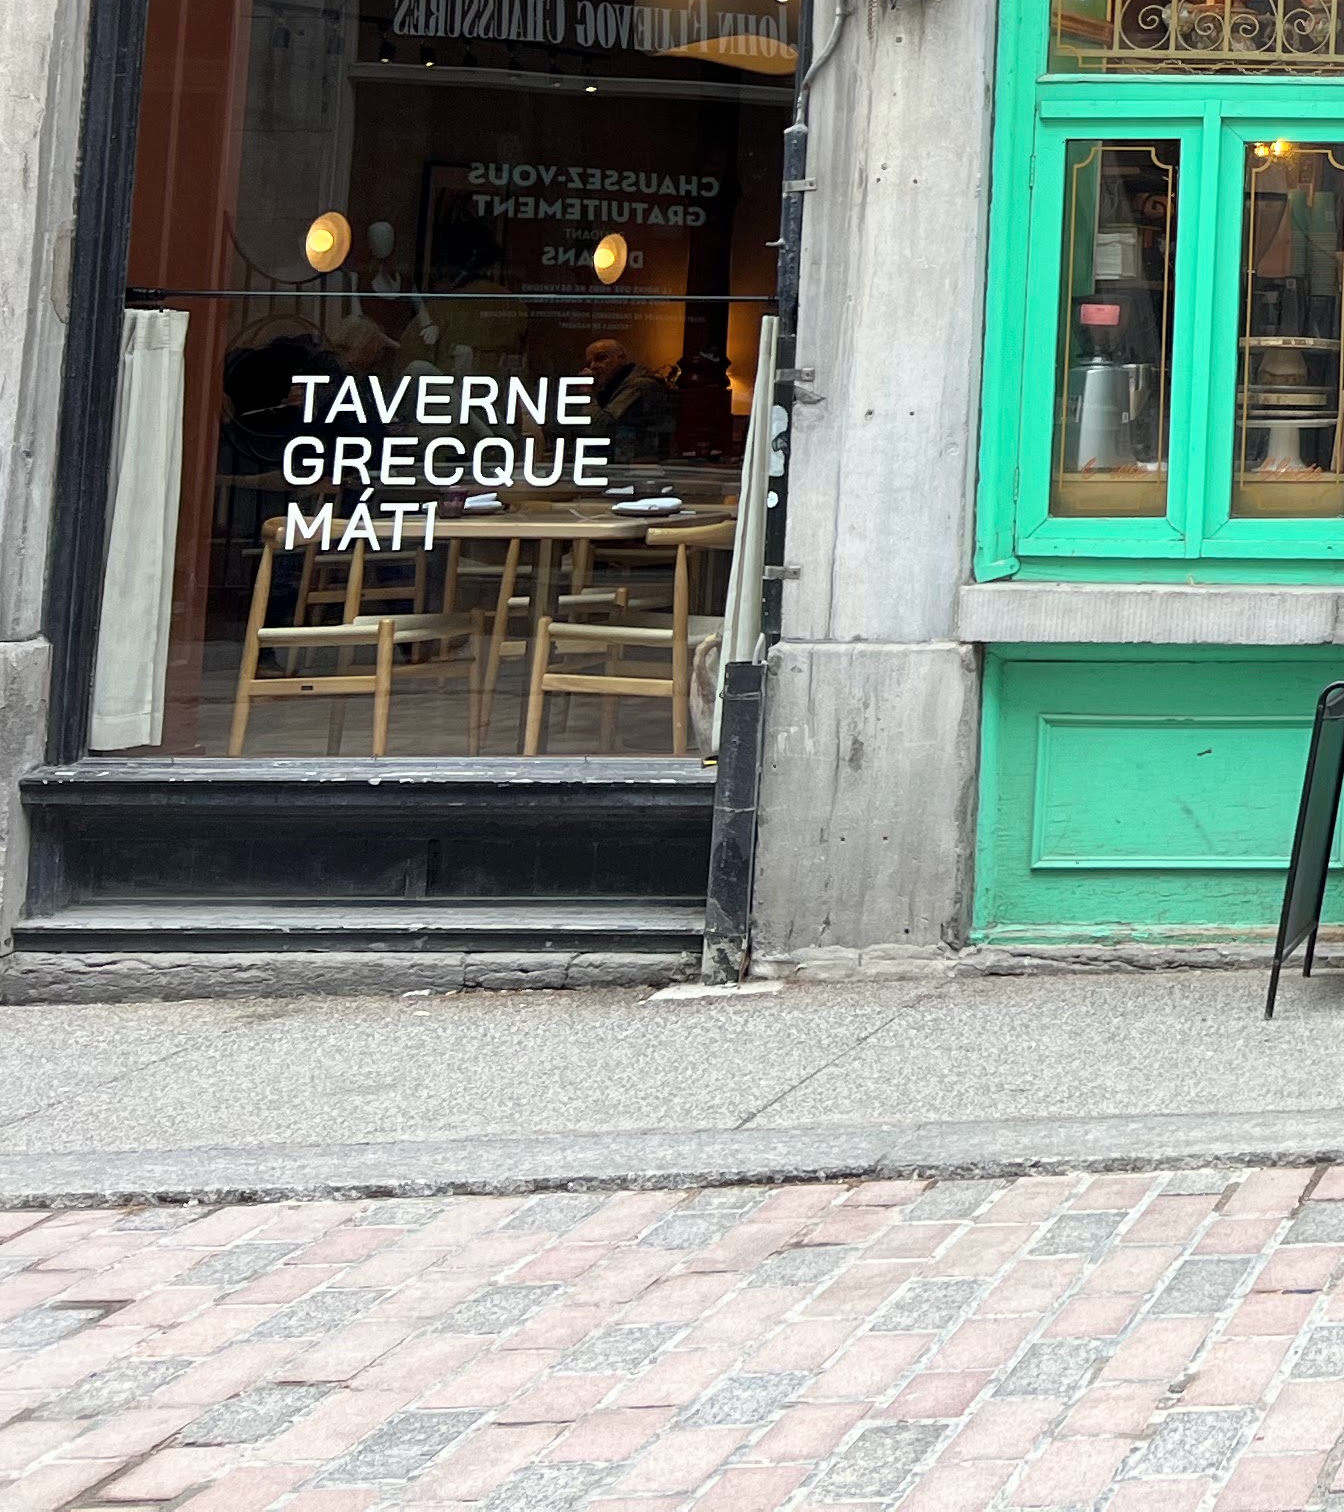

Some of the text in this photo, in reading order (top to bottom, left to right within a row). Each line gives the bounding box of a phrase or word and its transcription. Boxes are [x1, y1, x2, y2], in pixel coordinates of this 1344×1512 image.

[291, 374, 595, 425] TAVERNE
[283, 436, 611, 488] GRECQUE
[284, 487, 438, 552] MÁTI
